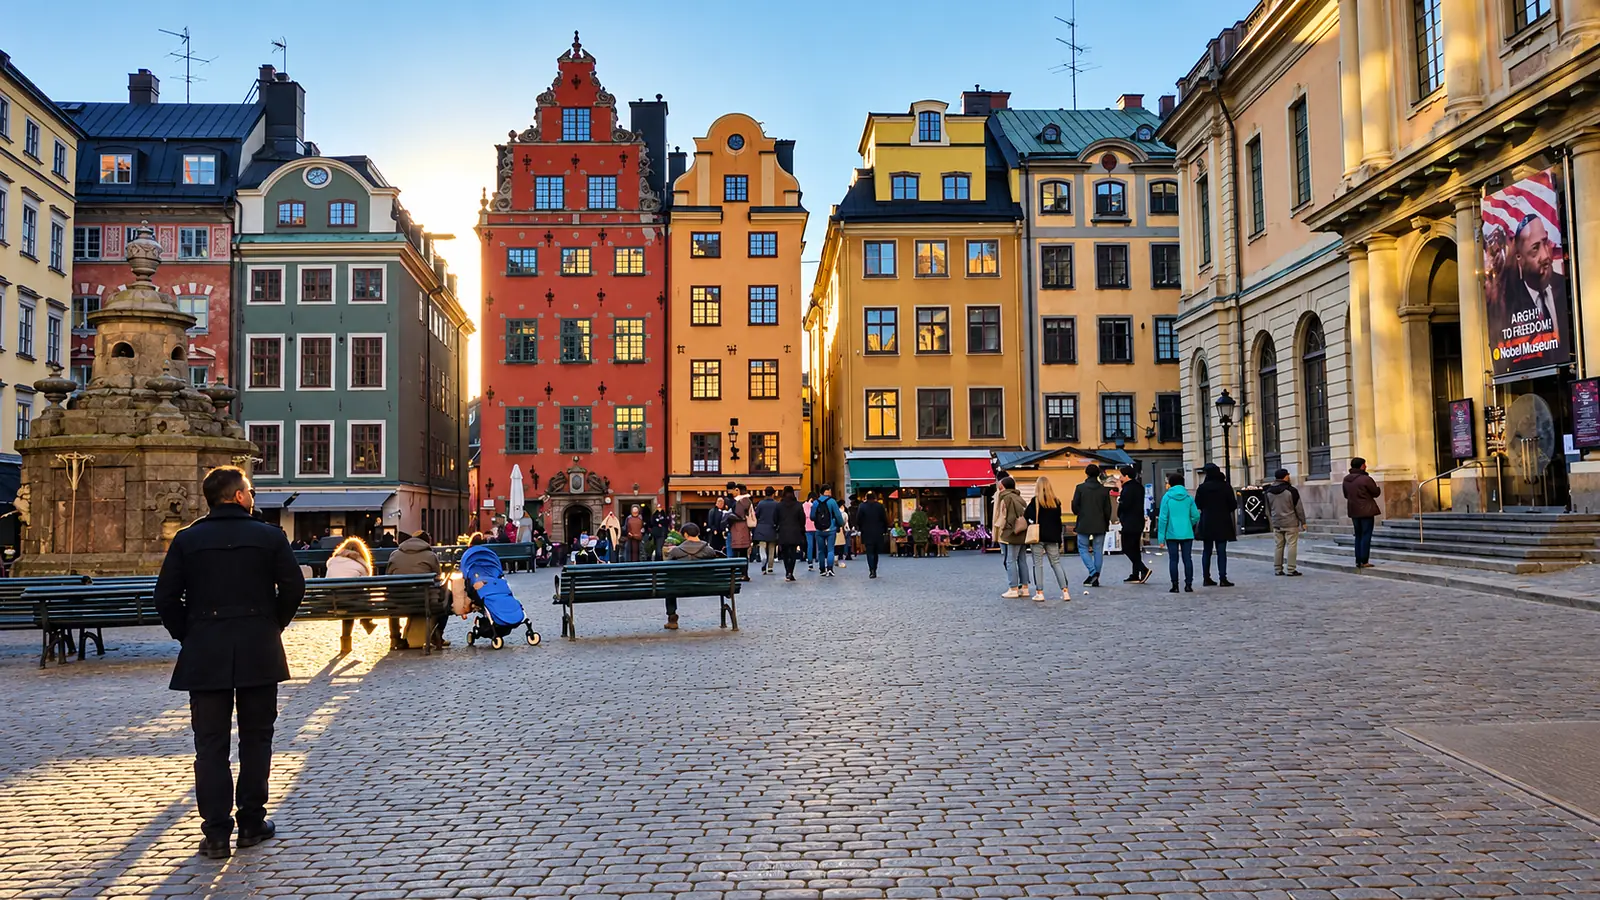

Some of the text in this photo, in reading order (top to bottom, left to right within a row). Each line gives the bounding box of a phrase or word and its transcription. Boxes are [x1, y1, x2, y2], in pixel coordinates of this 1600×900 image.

[1502, 318, 1552, 340] TO FREEDOM!
[1522, 339, 1558, 355] Museum
